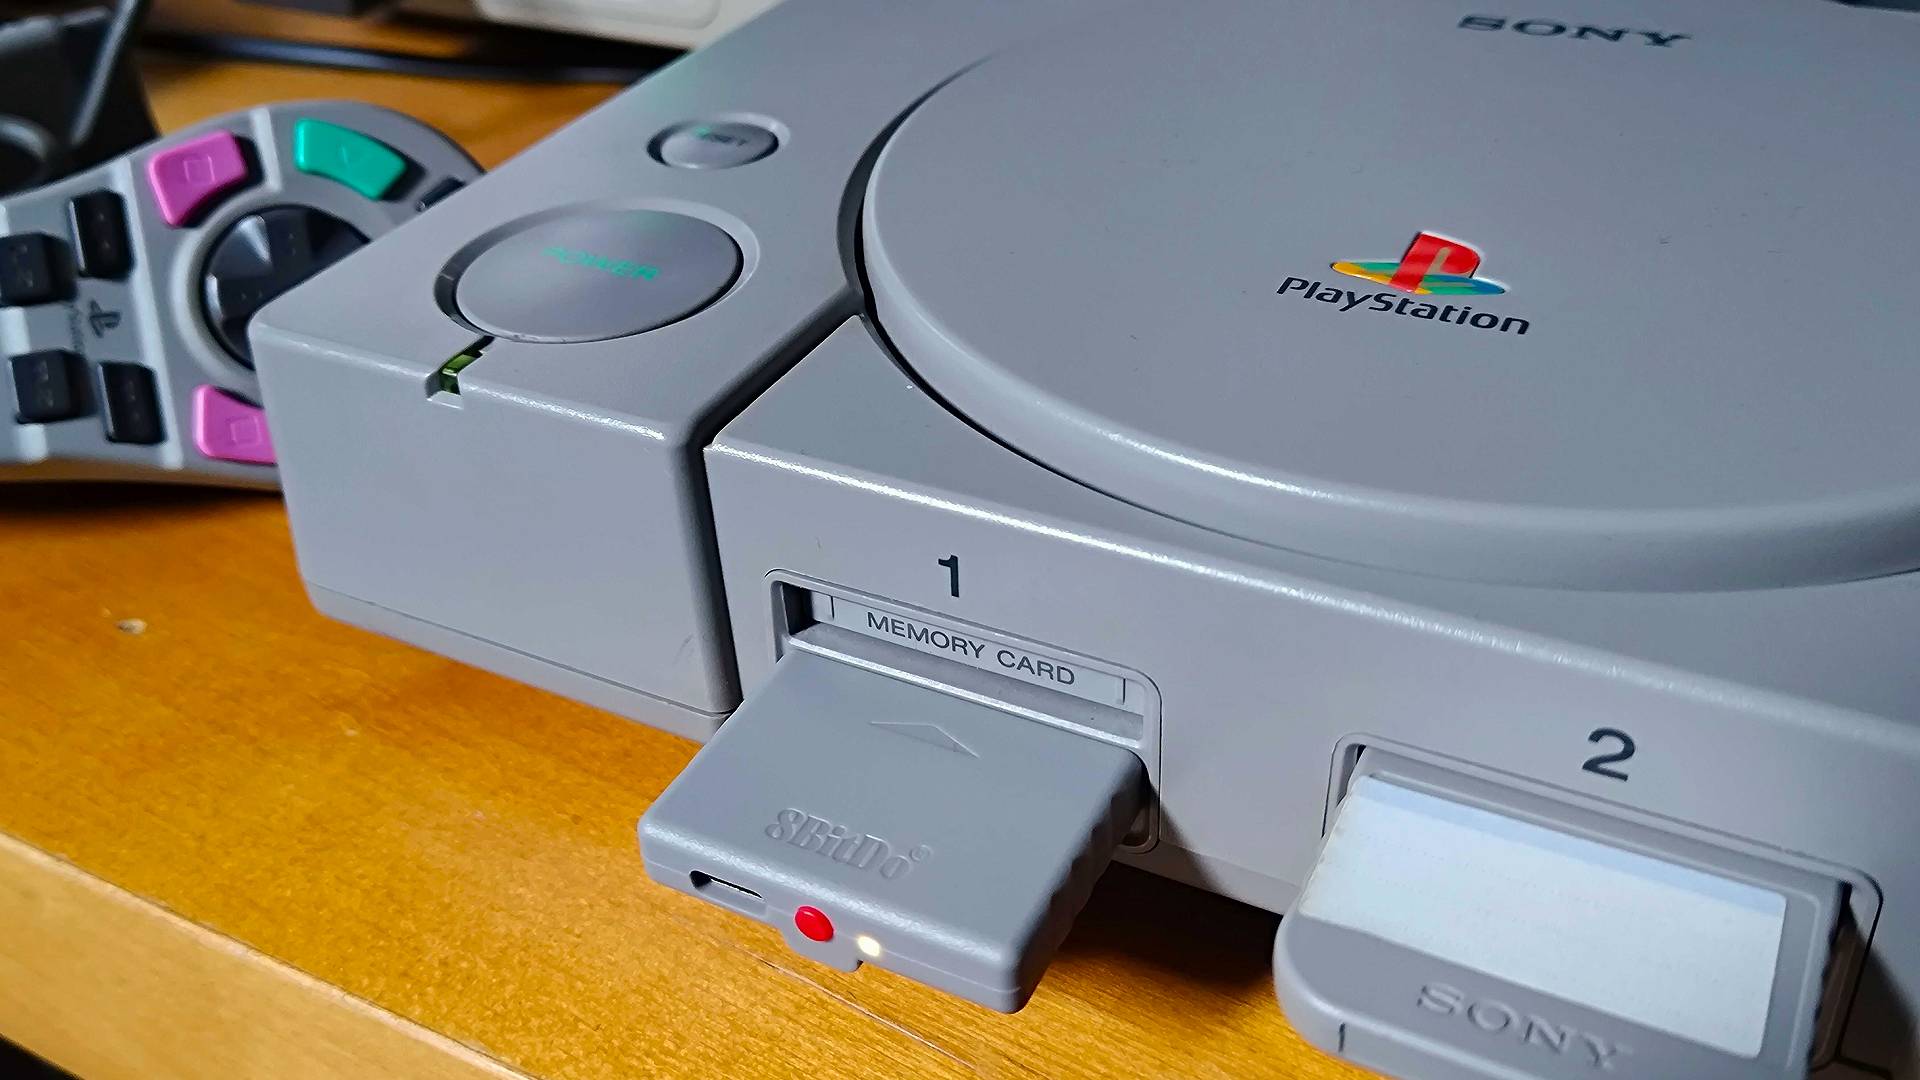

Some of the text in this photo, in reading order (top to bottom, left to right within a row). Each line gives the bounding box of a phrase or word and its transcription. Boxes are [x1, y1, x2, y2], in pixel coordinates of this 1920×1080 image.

[1457, 15, 1692, 47] SONY
[1276, 276, 1530, 335] PlayStation
[937, 554, 960, 598] 1
[866, 611, 1076, 686] MEMORY CARD
[1582, 727, 1636, 782] 2
[1416, 982, 1634, 1070] SONY
